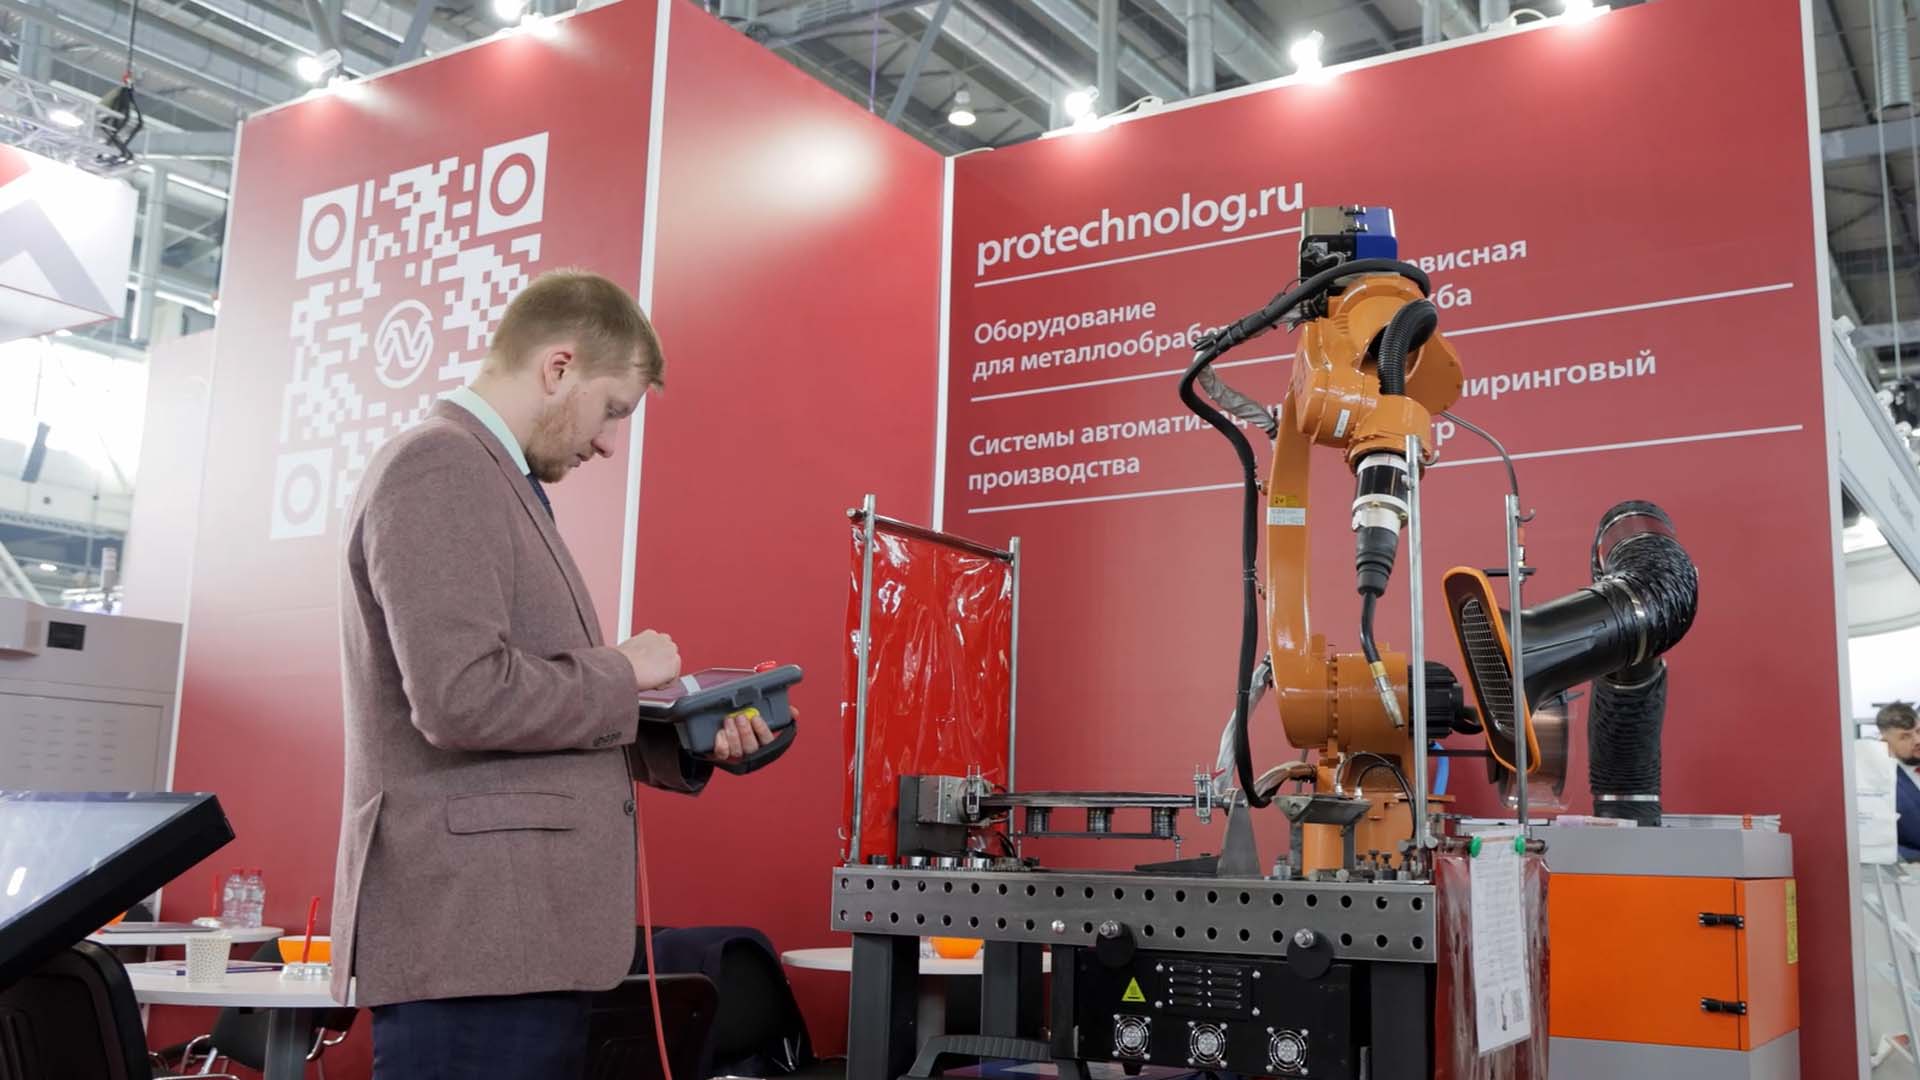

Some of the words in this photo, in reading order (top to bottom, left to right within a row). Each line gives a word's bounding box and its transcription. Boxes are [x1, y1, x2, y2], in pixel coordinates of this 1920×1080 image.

[977, 182, 1304, 277] protechnolog.ru
[974, 301, 1157, 345] Оборудование
[972, 358, 1015, 383] для
[969, 430, 1075, 457] Системы
[968, 457, 1140, 495] производства
